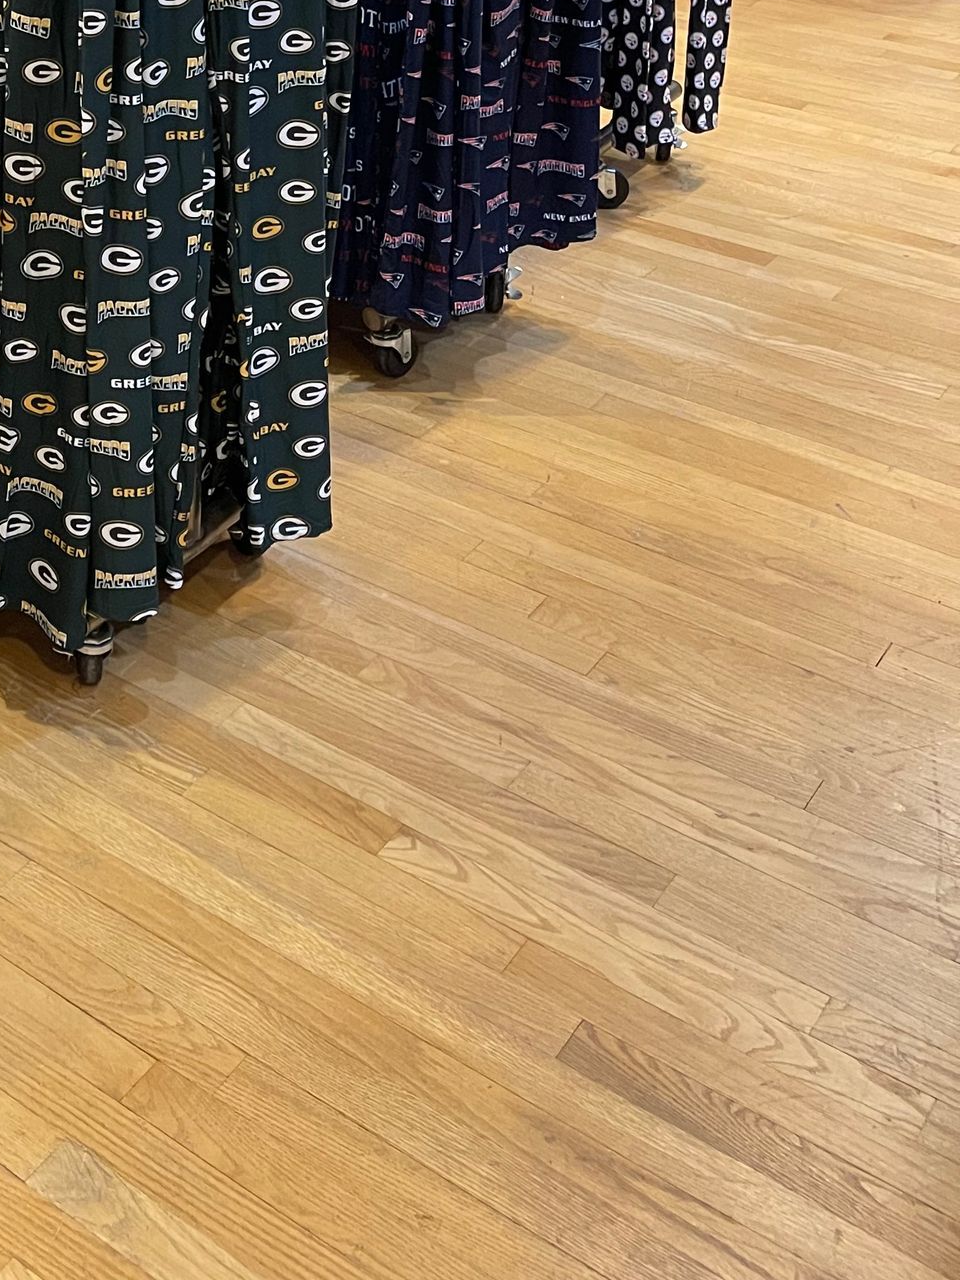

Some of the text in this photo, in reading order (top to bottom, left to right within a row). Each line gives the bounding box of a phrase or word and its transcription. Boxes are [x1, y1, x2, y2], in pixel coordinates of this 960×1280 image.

[572, 18, 602, 28] ENGLA
[278, 69, 326, 94] PACKE
[249, 166, 277, 182] BAY
[5, 193, 35, 207] BAY
[28, 213, 83, 237] PACKER
[543, 212, 598, 223] NEW ENGLA
[97, 299, 150, 324] PACKER
[253, 322, 283, 337] BAY
[51, 349, 87, 376] PACK
[111, 376, 151, 389] GREE
[151, 373, 188, 392] KERS
[57, 427, 91, 449] GREE
[90, 439, 131, 461] KERS
[112, 486, 155, 499] GREE
[43, 528, 87, 558] GREEN
[94, 566, 157, 589] PACKERS
